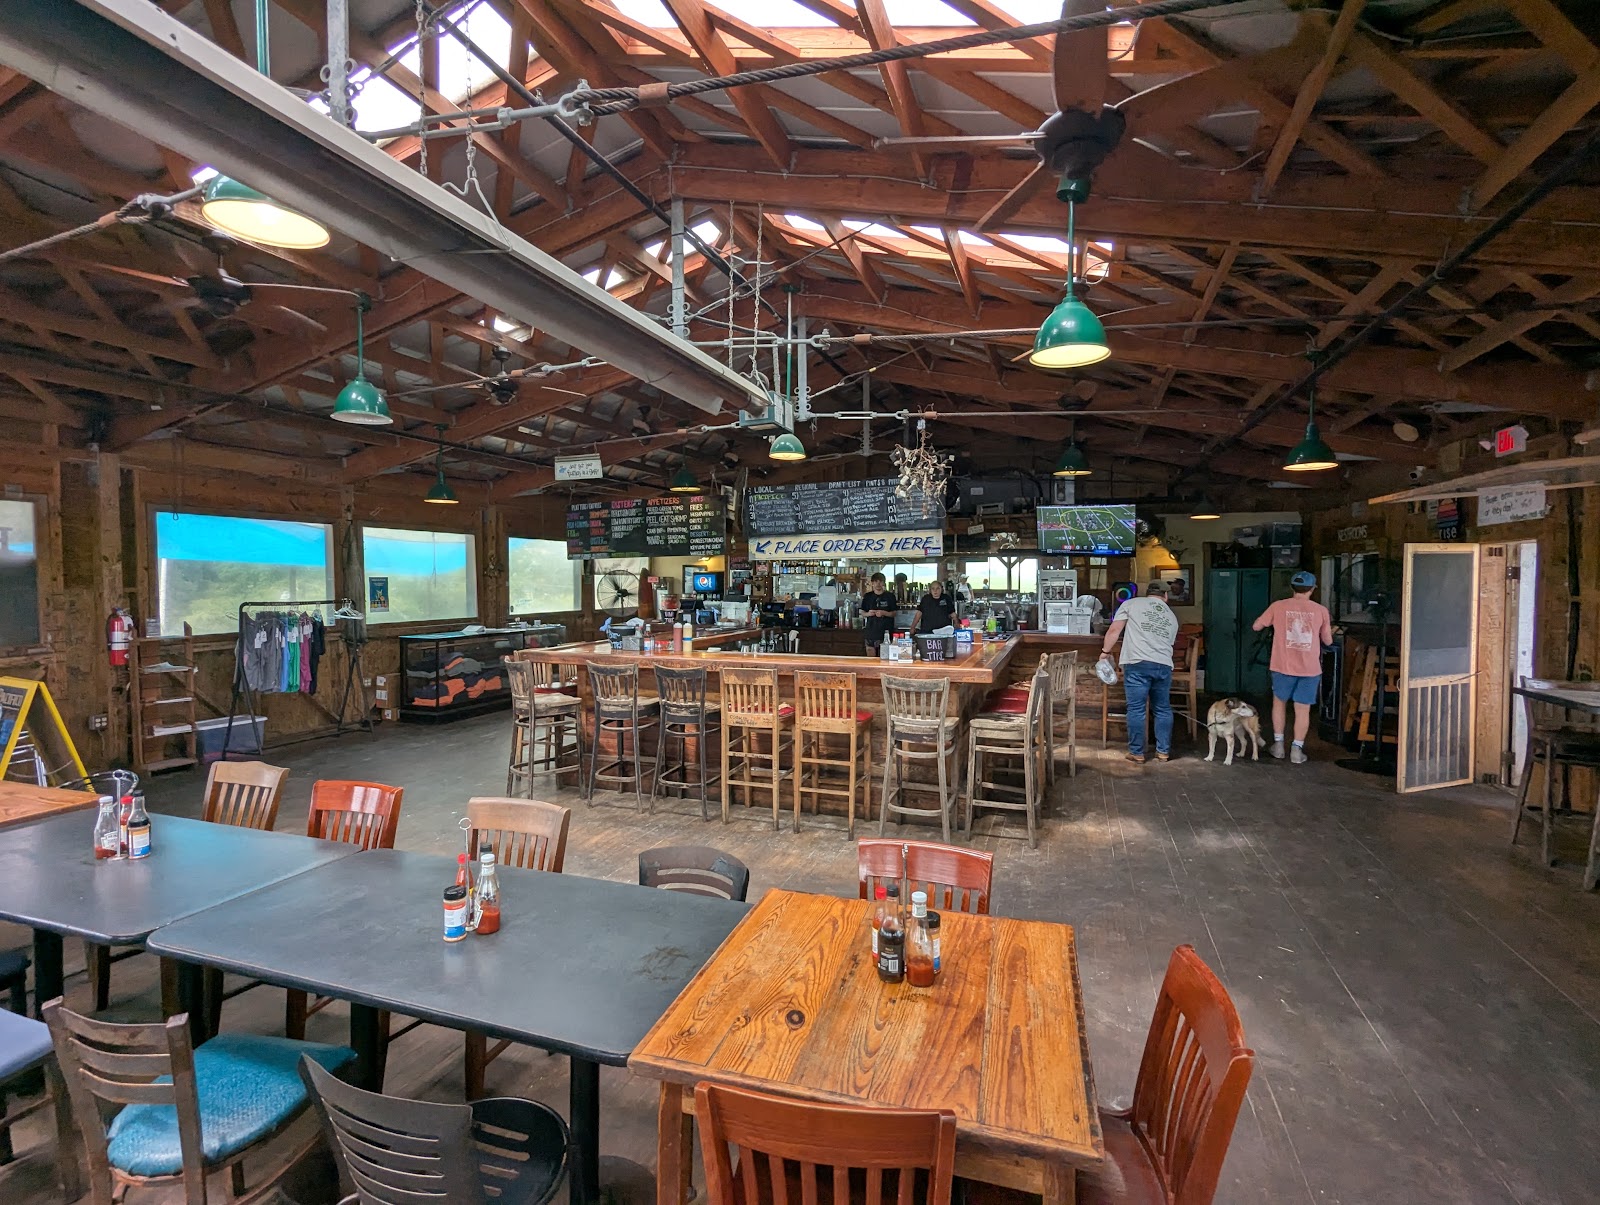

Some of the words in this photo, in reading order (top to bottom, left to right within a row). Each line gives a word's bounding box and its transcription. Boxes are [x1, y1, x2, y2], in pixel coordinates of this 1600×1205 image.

[848, 480, 860, 488] LIST
[647, 498, 680, 506] APPETIZERS
[1338, 525, 1368, 541] RESTROOMS
[775, 539, 821, 554] PLACE
[823, 538, 886, 553] ORDERS
[890, 536, 934, 552] HERE
[926, 639, 943, 650] BAR
[926, 651, 945, 662] TIPS
